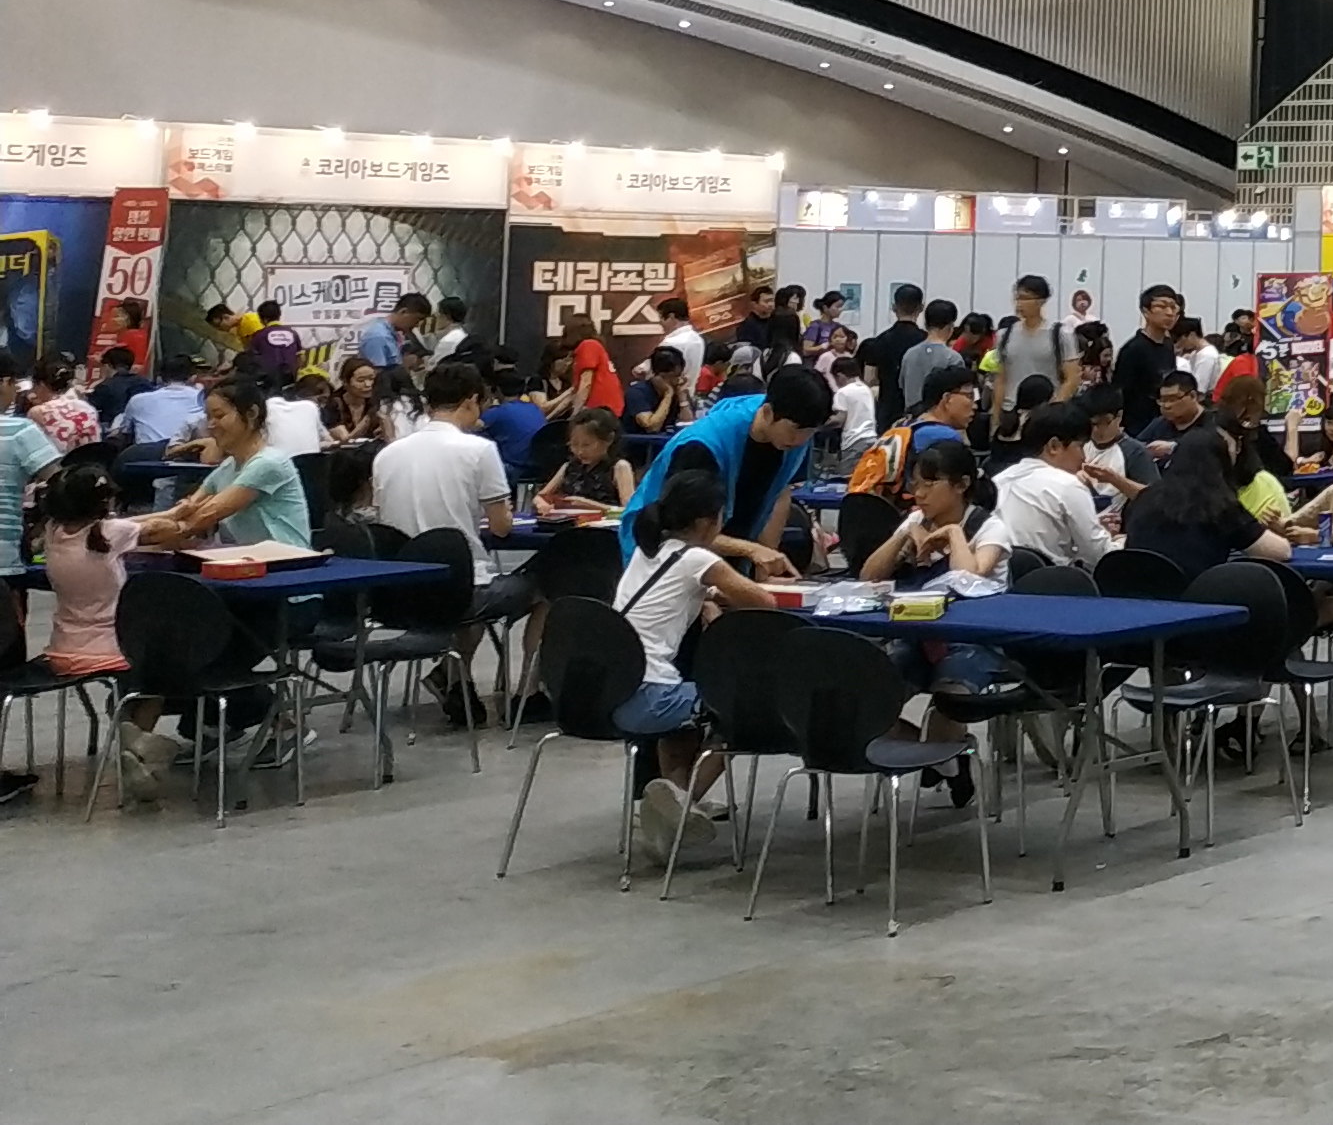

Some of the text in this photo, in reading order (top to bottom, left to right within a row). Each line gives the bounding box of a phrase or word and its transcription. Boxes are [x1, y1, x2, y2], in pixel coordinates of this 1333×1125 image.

[0, 143, 88, 167] 드게임즈
[188, 148, 233, 161] 보드게임
[315, 158, 450, 183] 코리아보드게임즈
[627, 173, 732, 194] 코리아보드게임즈
[105, 256, 152, 296] 50
[533, 261, 677, 292] 테라포밍
[274, 275, 370, 306] 이스케이프
[546, 294, 665, 338] 마스
